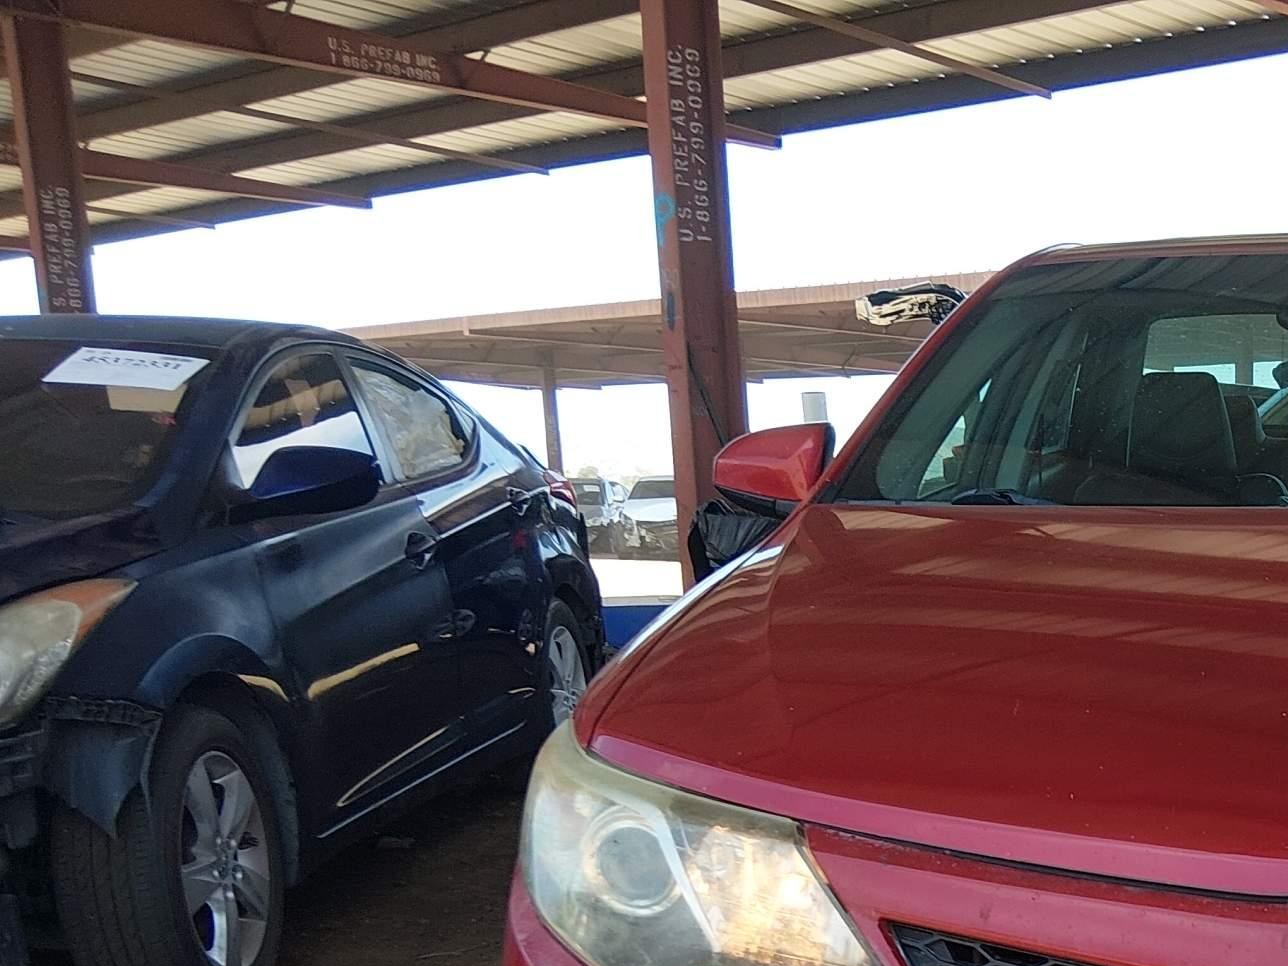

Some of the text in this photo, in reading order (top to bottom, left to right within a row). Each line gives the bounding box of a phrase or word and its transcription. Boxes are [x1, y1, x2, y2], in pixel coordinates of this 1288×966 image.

[327, 36, 355, 54] U.S.
[360, 43, 411, 65] PREFAB
[667, 45, 695, 242] U.S. PREFAB INC.
[43, 222, 64, 285] PREFAB
